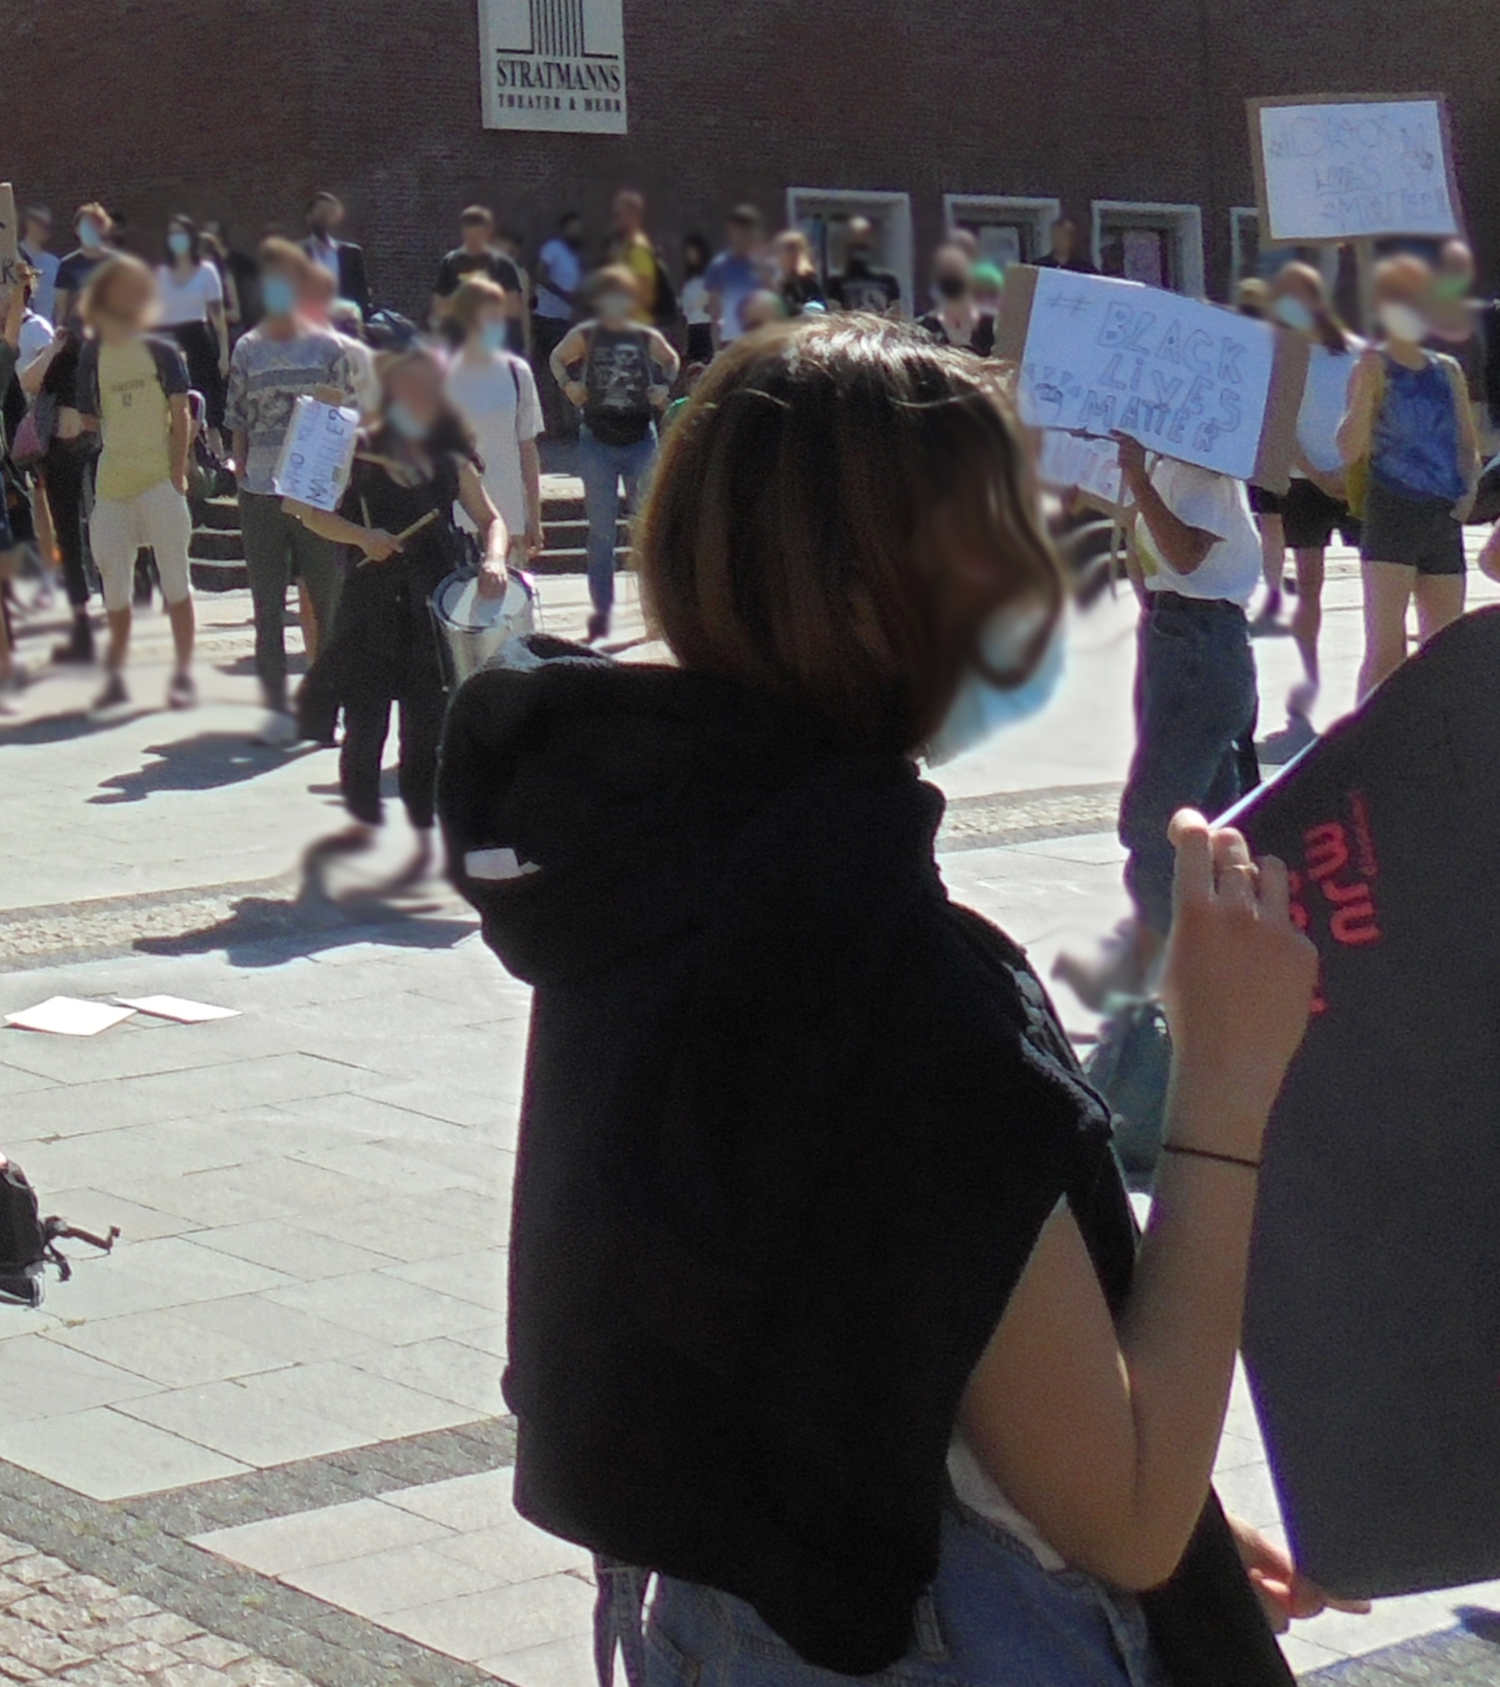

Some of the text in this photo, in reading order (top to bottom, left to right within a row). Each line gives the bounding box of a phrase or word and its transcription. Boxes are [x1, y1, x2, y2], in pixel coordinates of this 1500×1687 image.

[496, 59, 621, 93] STRATMANNS
[497, 92, 621, 112] THEATER & MEHR
[1099, 301, 1245, 384] BLACK
[1079, 390, 1218, 452] MATTER
